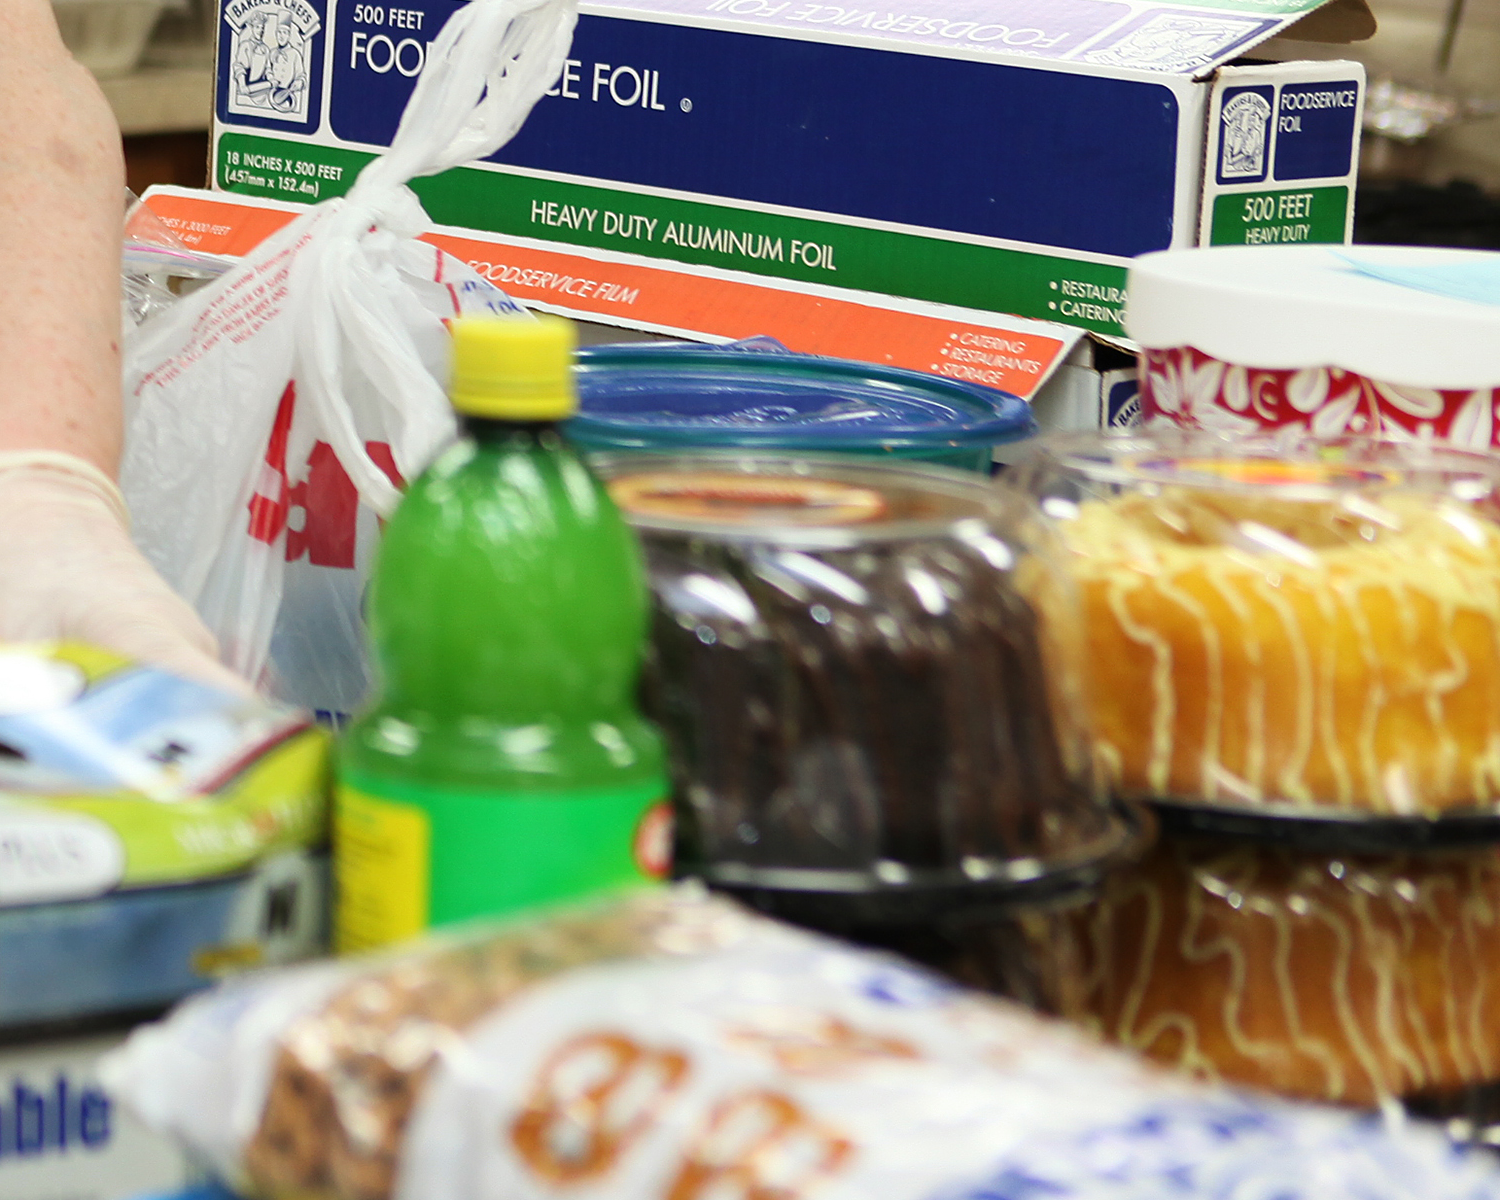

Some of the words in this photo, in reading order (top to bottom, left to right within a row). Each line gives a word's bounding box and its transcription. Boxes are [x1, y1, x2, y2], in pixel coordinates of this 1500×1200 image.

[353, 3, 384, 26] 500
[389, 8, 425, 31] FEET
[789, 3, 1070, 48] FOODSERVICE
[592, 62, 666, 112] FOIL
[1280, 90, 1356, 111] FOODSERVICE
[1278, 115, 1302, 133] FOIL
[226, 150, 240, 166] 18
[243, 153, 283, 171] INCHES
[285, 160, 293, 173] X
[294, 161, 316, 177] 500
[317, 164, 344, 182] FEET
[224, 164, 266, 187] (457mm
[267, 176, 275, 189] x
[278, 176, 320, 198] 152.4m)
[1241, 196, 1275, 223] 500
[1277, 193, 1314, 220] FEET
[209, 225, 233, 237] FEET
[530, 199, 599, 232] HEAVY
[602, 211, 658, 242] DUTY
[662, 220, 784, 263] ALUMINUM
[790, 239, 837, 271] FOIL
[1244, 226, 1281, 245] HEAVY
[1281, 224, 1311, 243] DUTY
[466, 259, 597, 299] FOODSERVICE
[592, 281, 641, 305] FILM
[1061, 279, 1128, 305] RESTAURA
[959, 332, 1027, 355] CATERING
[938, 362, 1005, 385] STORAGE
[950, 346, 1042, 375] RESTAURANTS
